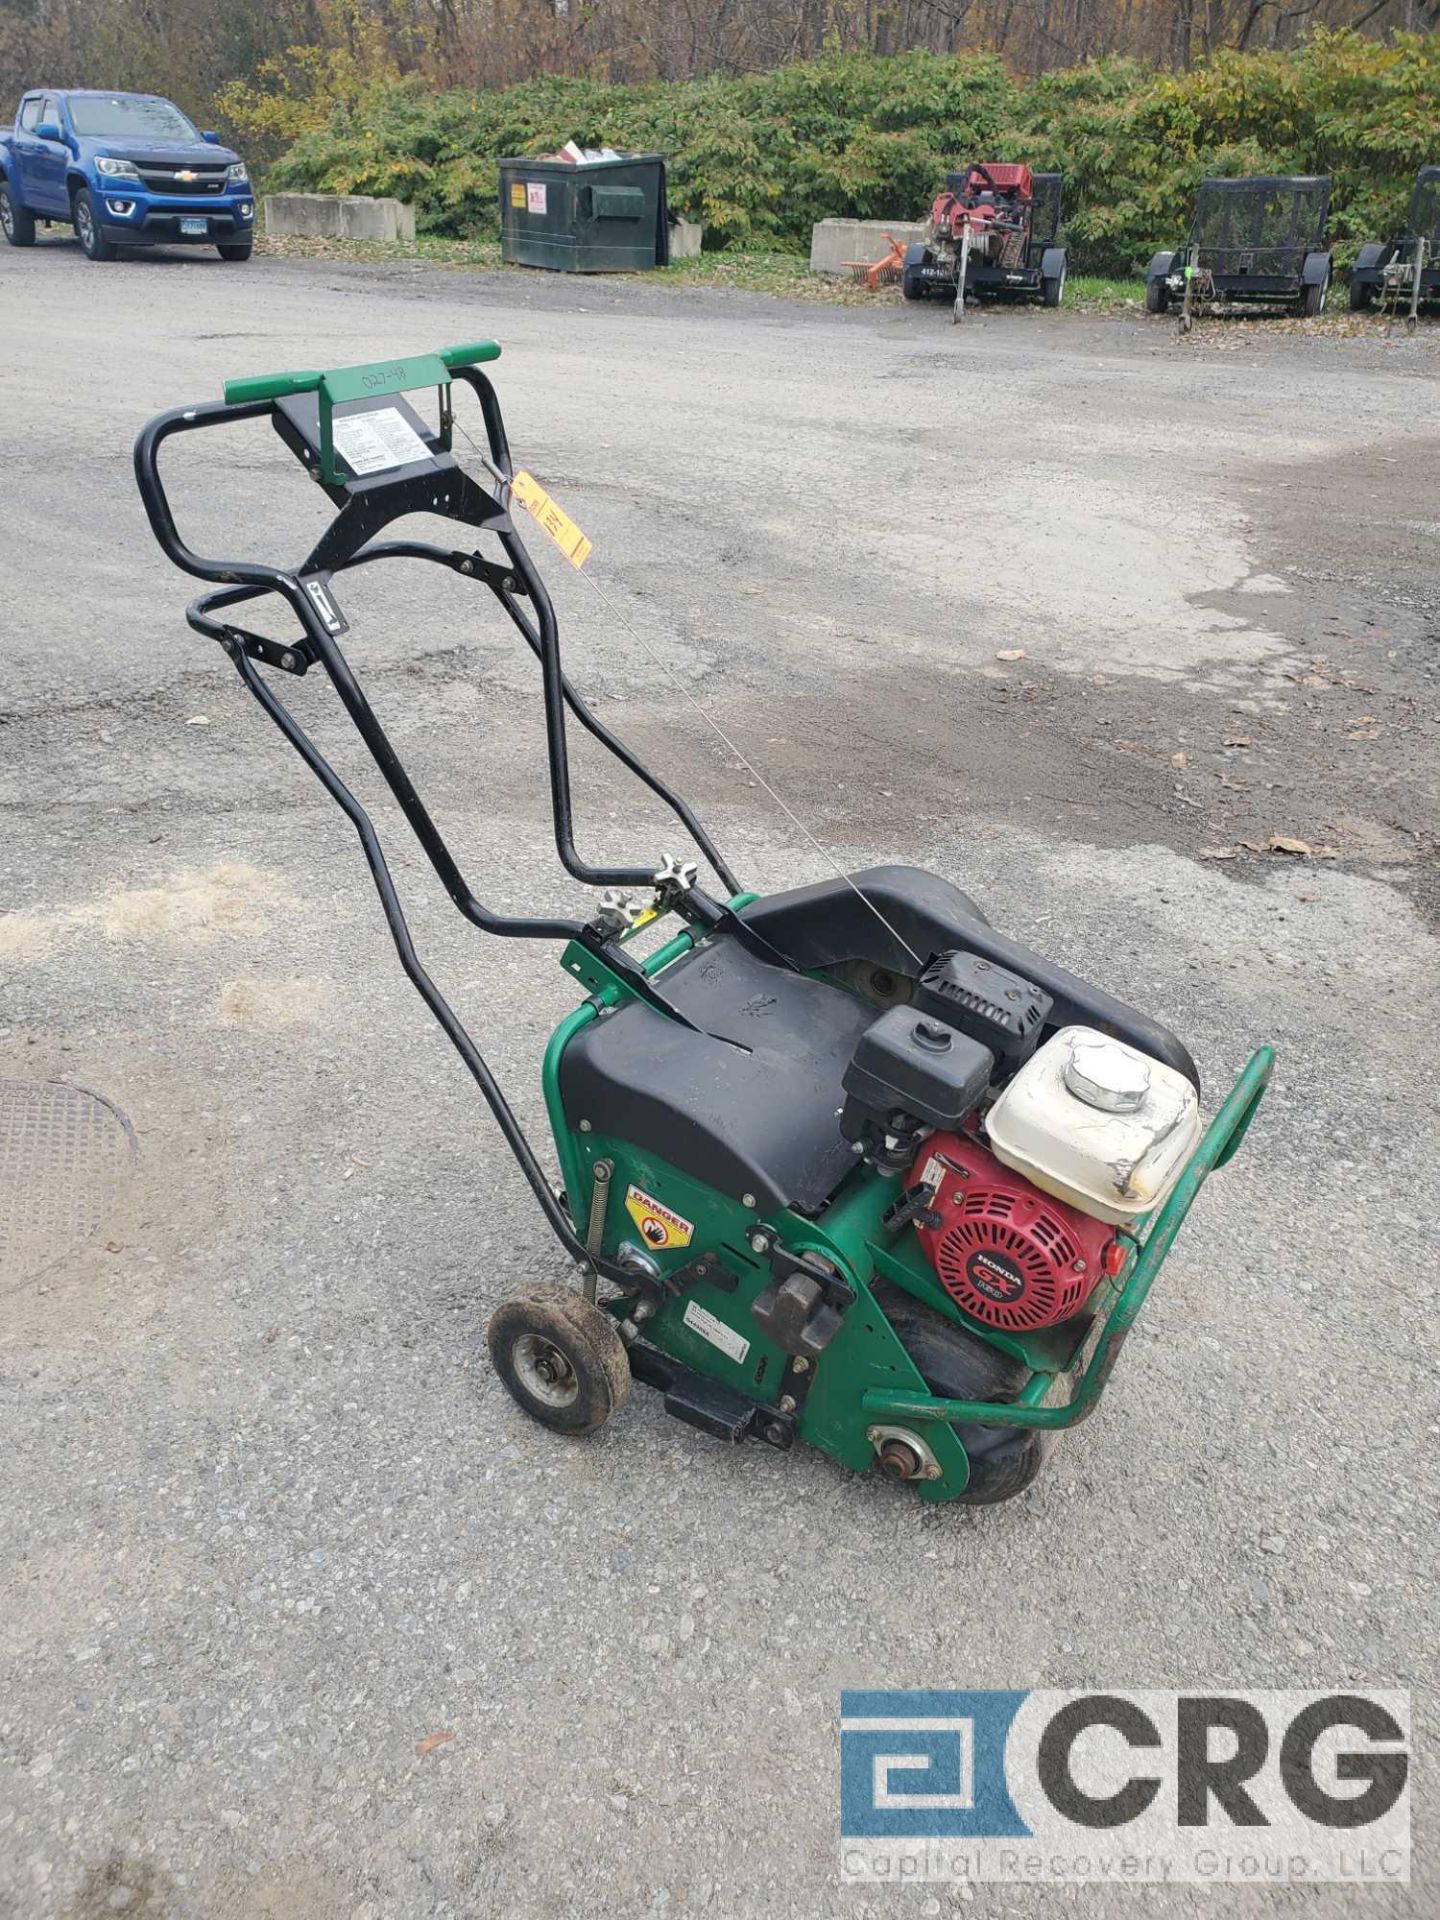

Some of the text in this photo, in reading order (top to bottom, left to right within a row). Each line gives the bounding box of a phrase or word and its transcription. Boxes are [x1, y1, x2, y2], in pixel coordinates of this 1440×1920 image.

[633, 1191, 690, 1233] DANGER
[972, 1265, 1019, 1296] GX
[977, 1254, 1022, 1286] HONDA
